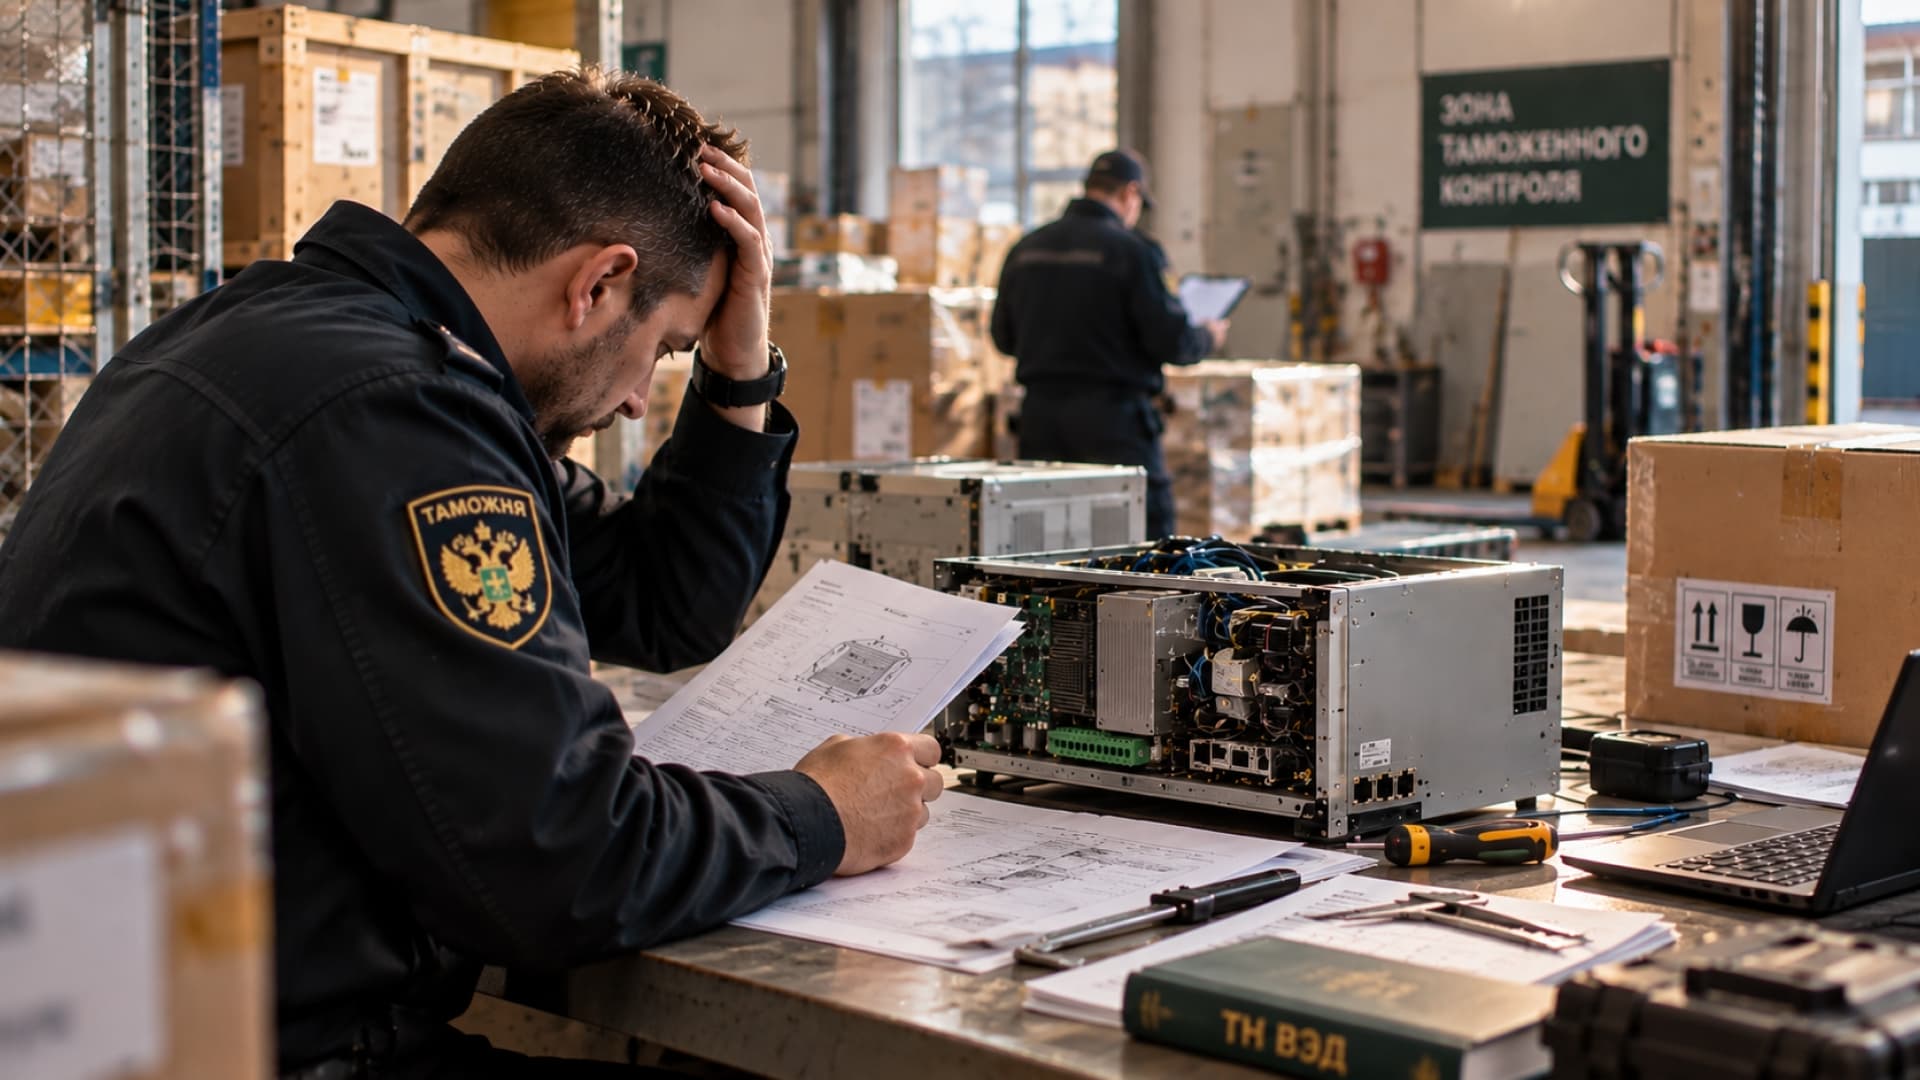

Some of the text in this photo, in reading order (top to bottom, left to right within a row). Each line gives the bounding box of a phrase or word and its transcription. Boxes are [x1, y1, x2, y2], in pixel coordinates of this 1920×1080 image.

[1440, 92, 1513, 124] ЗОНА
[1439, 126, 1647, 164] ТАМОЖЕННОГО
[1440, 170, 1581, 204] КОНТРОЛЯ
[421, 496, 526, 524] ТАМОЖНЯ
[1221, 1009, 1347, 1076] ТН ВЭД
